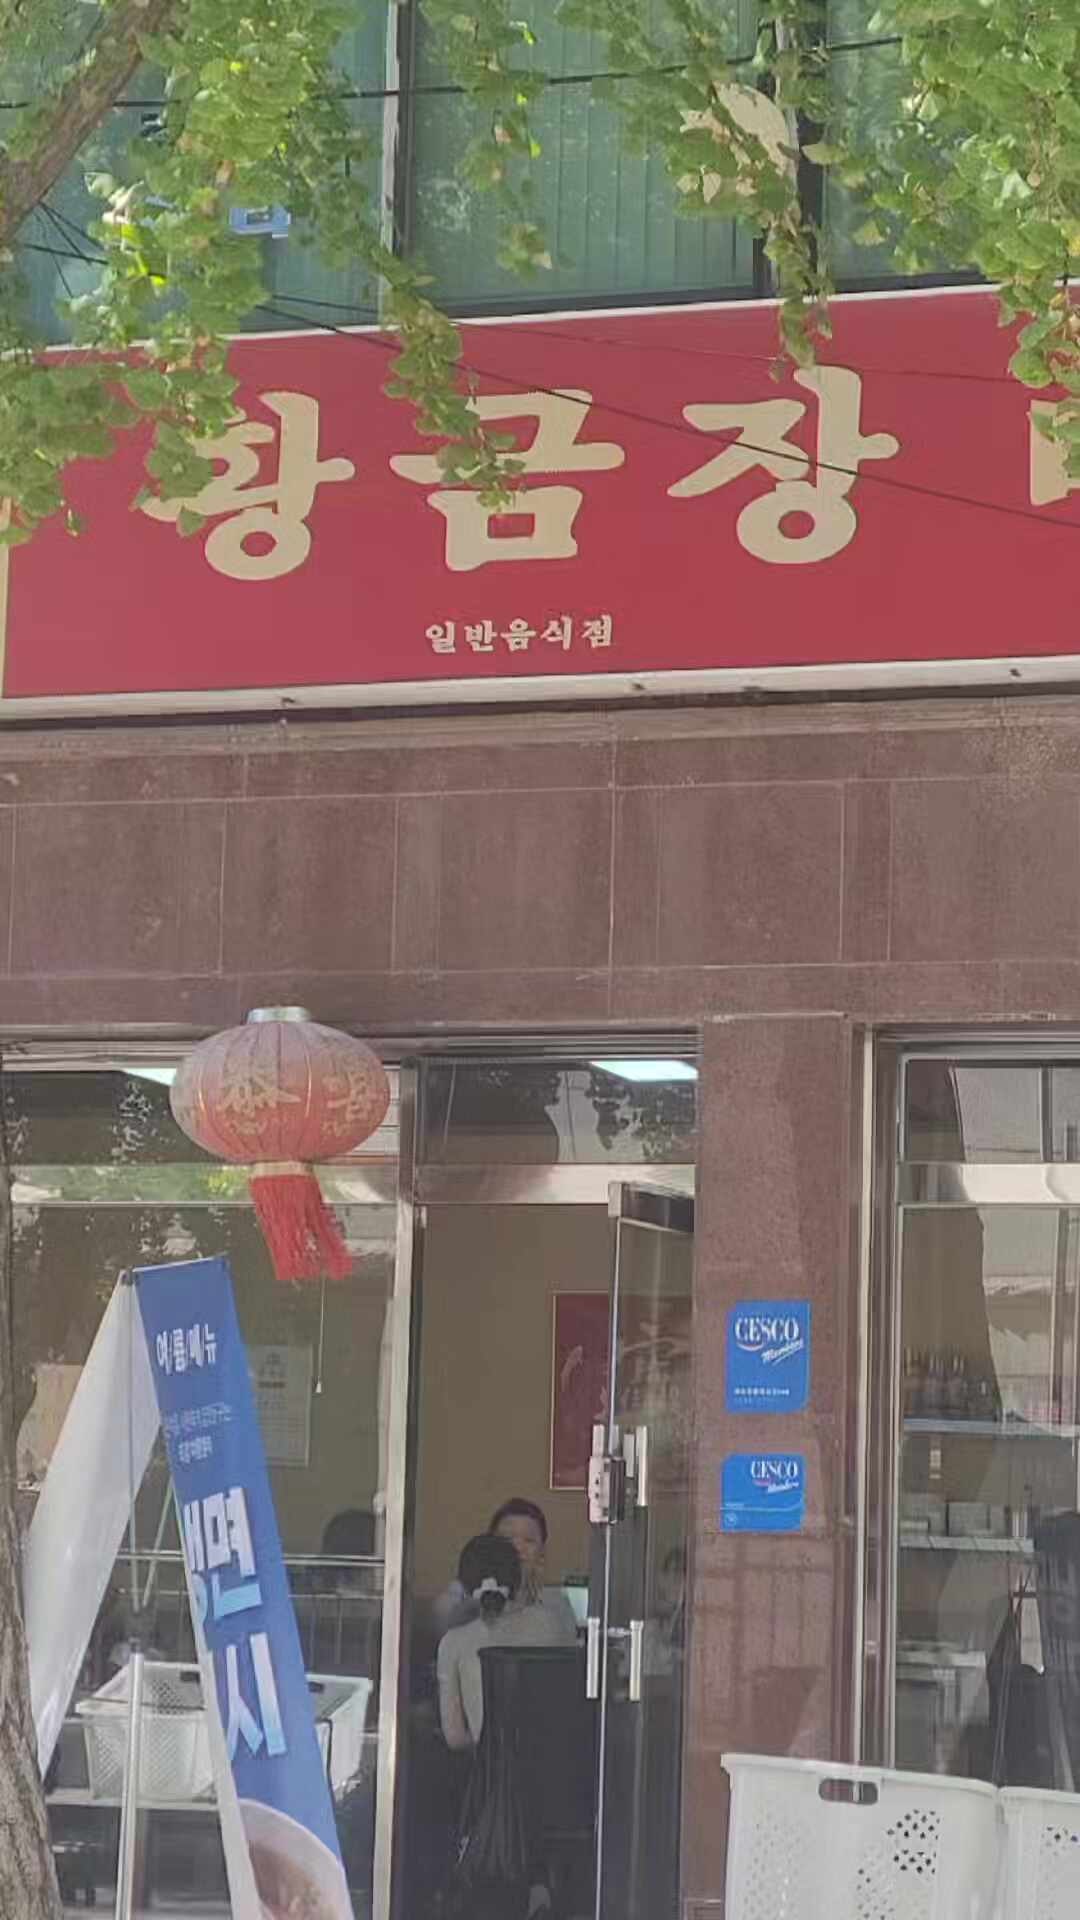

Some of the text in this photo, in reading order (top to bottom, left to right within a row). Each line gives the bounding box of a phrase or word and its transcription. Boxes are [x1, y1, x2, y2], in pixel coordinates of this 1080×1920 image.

[140, 365, 900, 580] 황금장
[425, 614, 612, 653] 일반음식점
[735, 1317, 799, 1341] CESCO
[156, 1323, 216, 1375] 여름메뉴
[751, 1460, 799, 1479] CESCO
